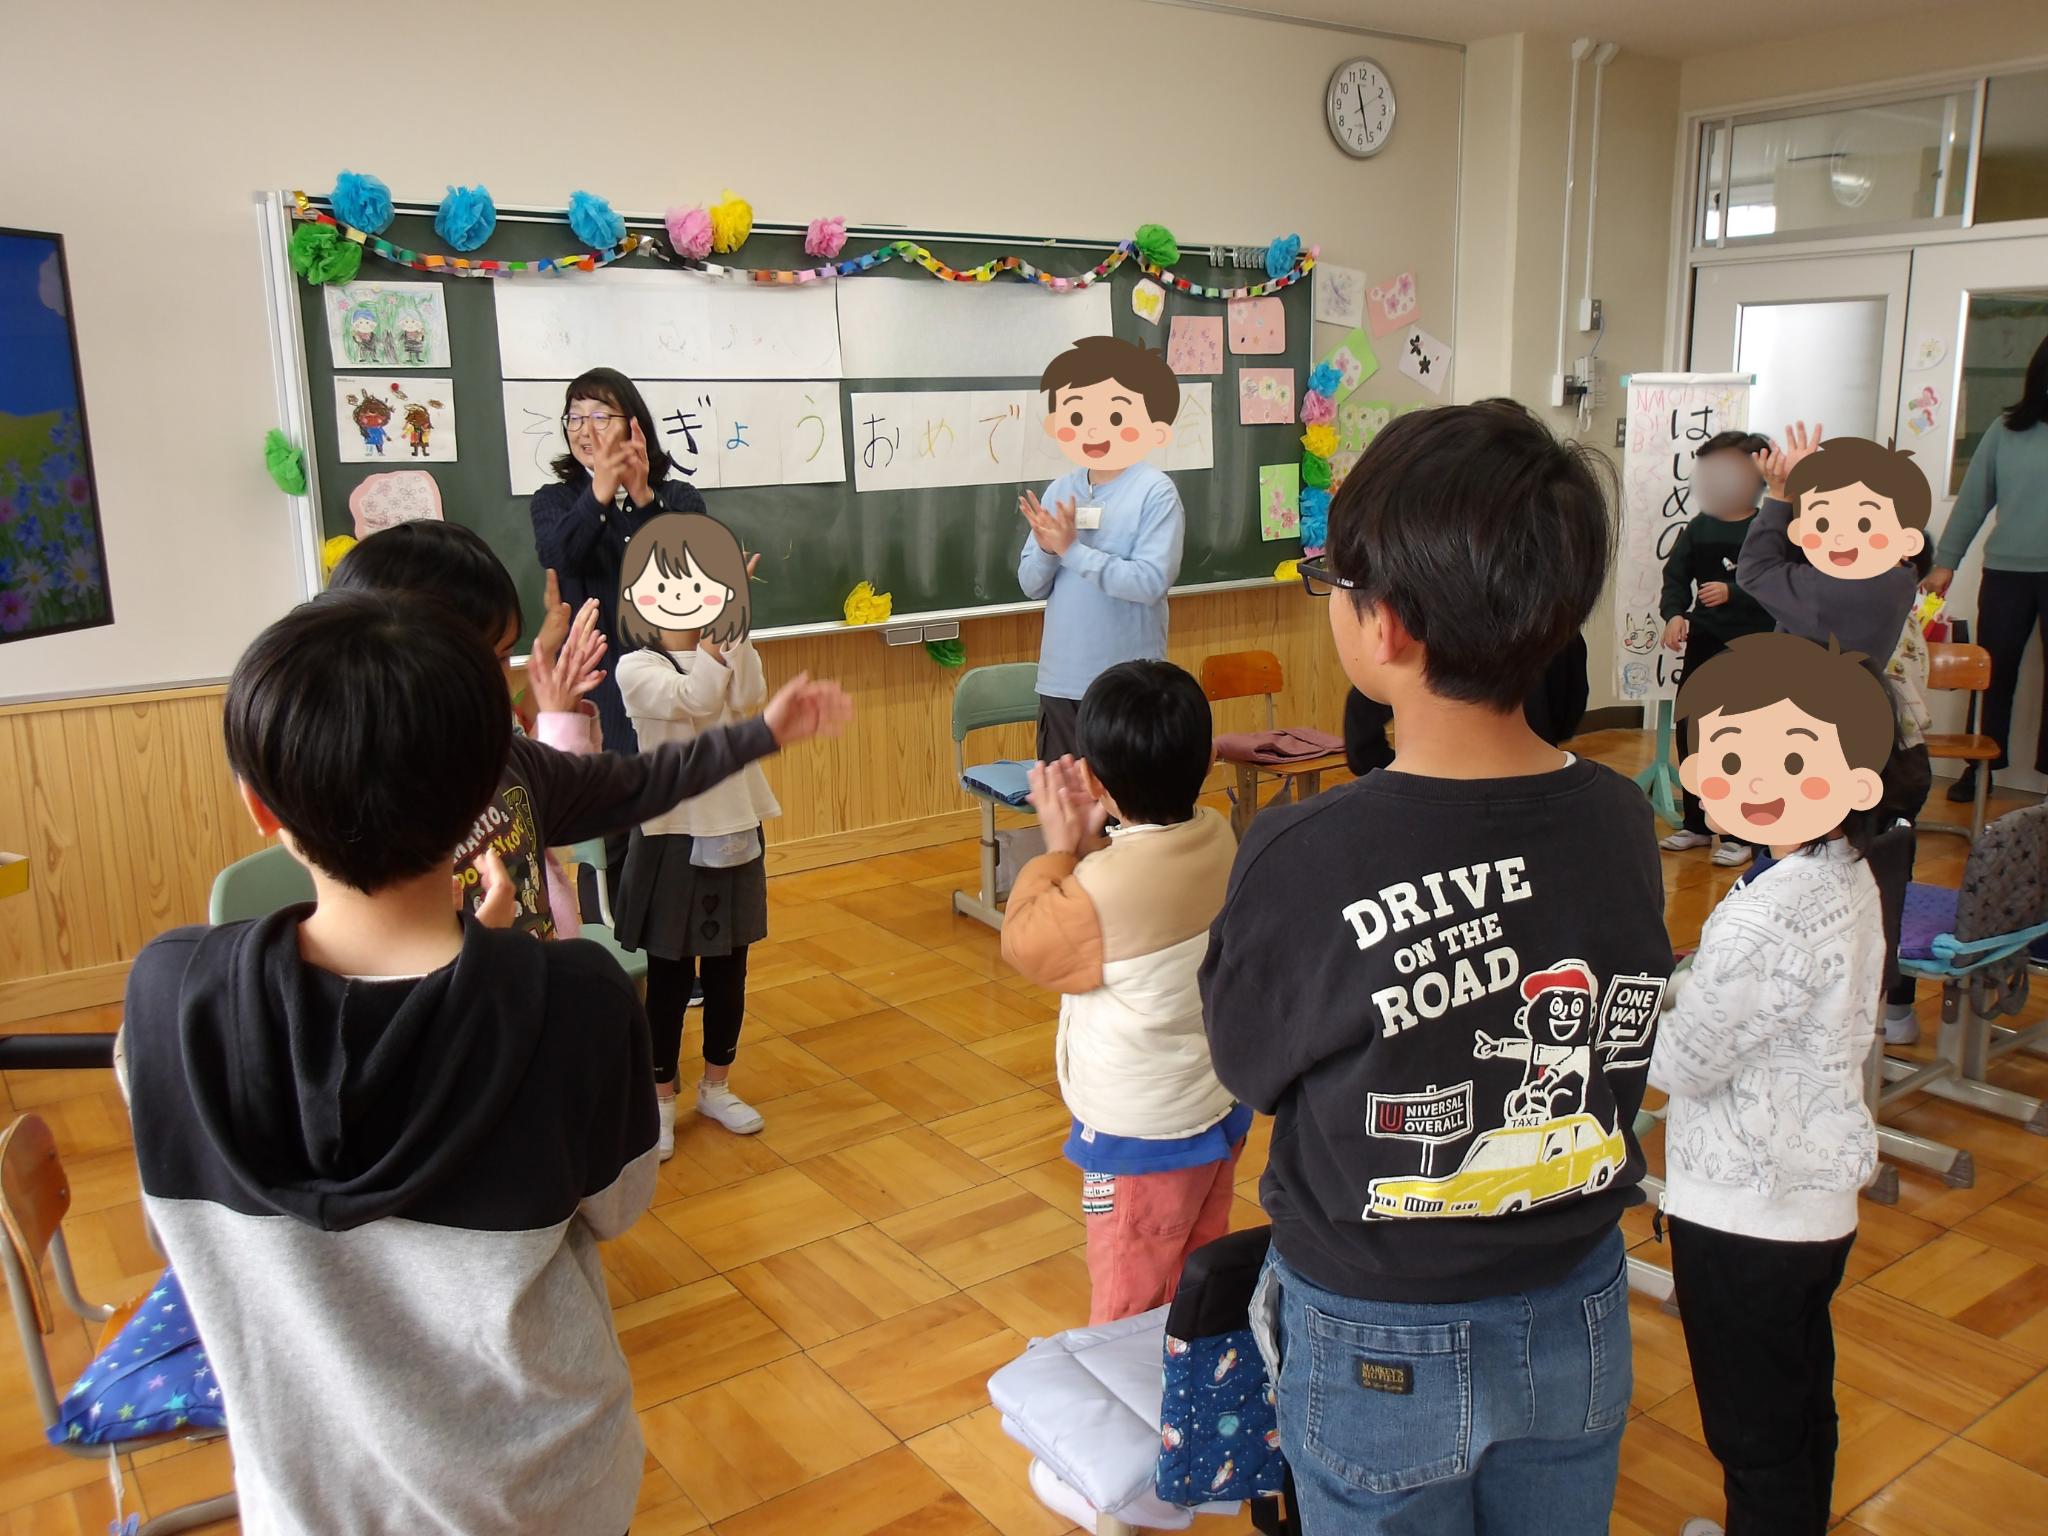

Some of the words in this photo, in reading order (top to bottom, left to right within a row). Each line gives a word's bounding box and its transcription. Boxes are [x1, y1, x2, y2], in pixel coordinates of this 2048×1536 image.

[1348, 71, 1356, 84] 11
[1359, 68, 1367, 80] 12
[1340, 82, 1349, 94] 10
[1336, 98, 1342, 110] 9
[1381, 104, 1387, 116] 3
[1338, 115, 1345, 127] 8
[1376, 120, 1382, 132] 4
[1347, 127, 1353, 139] 7
[1357, 133, 1363, 145] 6
[1368, 131, 1375, 143] 5
[1342, 856, 1532, 950] DRIVE
[1393, 937, 1435, 974] ON
[1438, 912, 1503, 955] THE
[1371, 946, 1519, 1038] ROAD
[1616, 987, 1654, 1008] ONE
[1610, 1006, 1650, 1026] WAY
[1379, 1097, 1464, 1132] UNIVERSAL
[1404, 1113, 1464, 1133] OVERALL
[1511, 1116, 1540, 1129] TAXI
